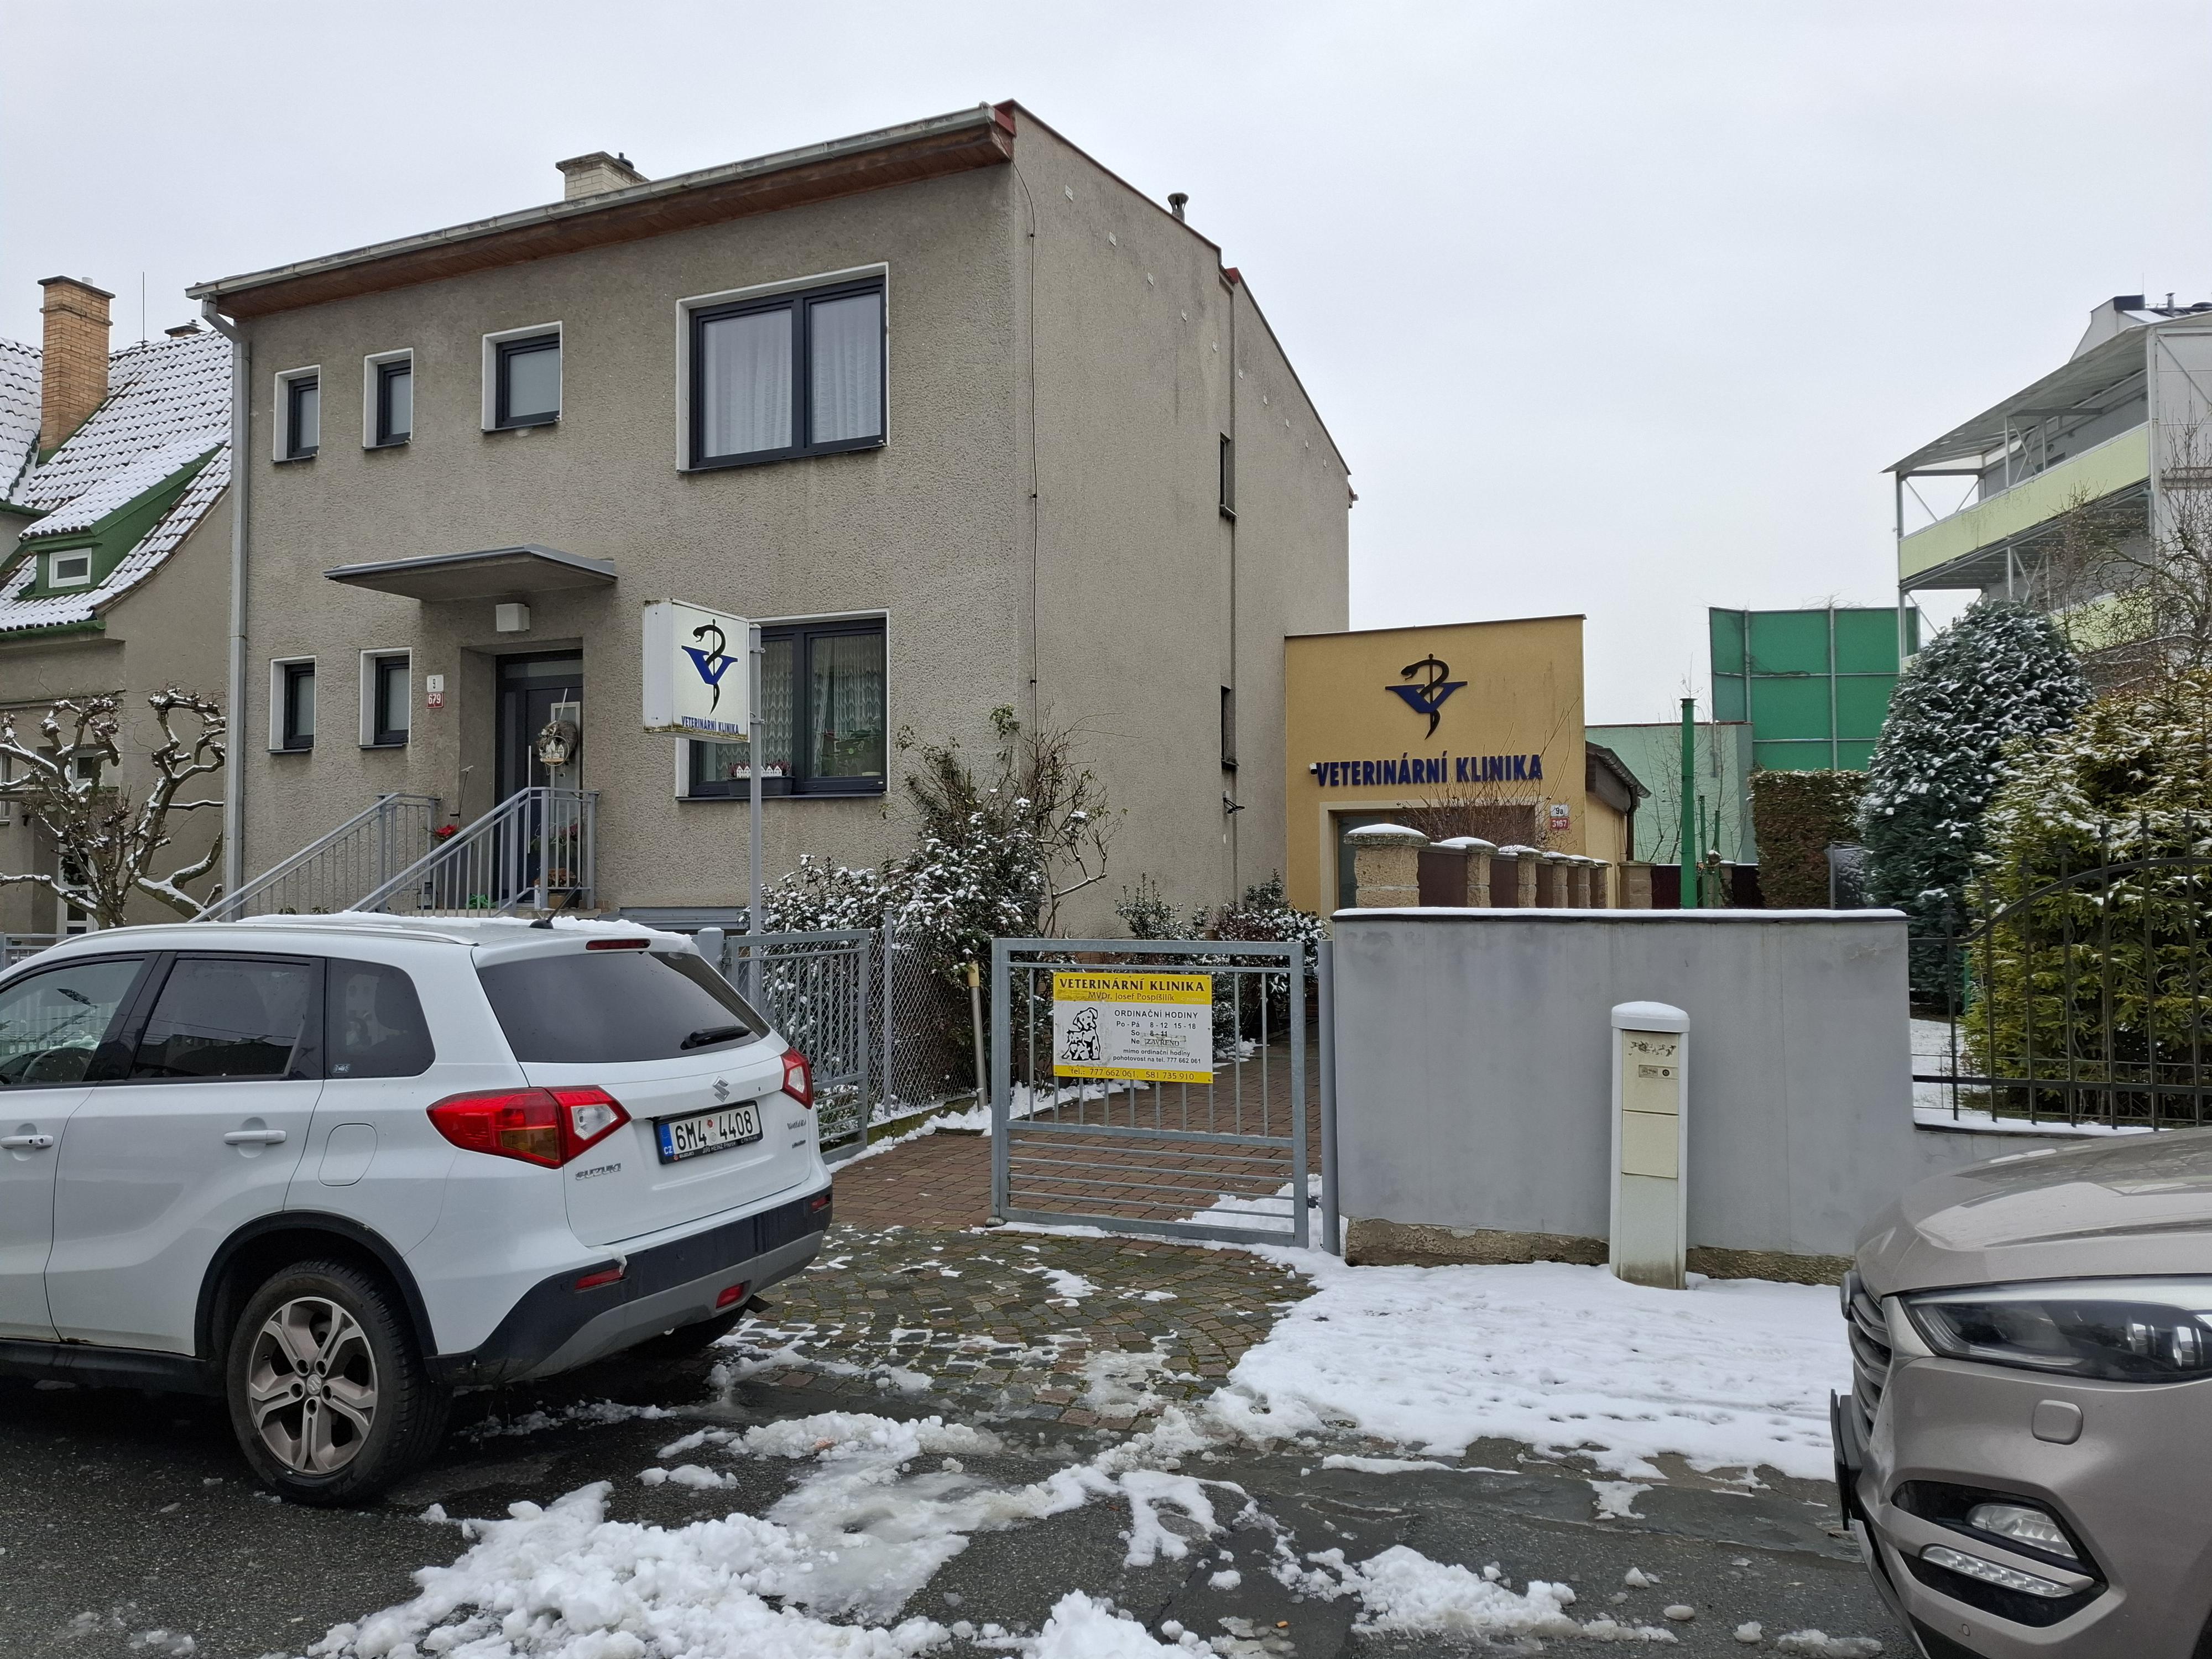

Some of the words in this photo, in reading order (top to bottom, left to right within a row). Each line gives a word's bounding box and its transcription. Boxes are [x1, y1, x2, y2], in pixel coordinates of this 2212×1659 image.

[432, 679, 436, 689] 9
[428, 693, 441, 704] 679
[681, 715, 716, 731] VETERINÁRNÍ
[718, 722, 739, 734] KLINIKA
[1316, 750, 1448, 786] VETERINÁRNÍ
[1456, 754, 1543, 782] KLINIKA
[1060, 977, 1144, 990] VETERINÁRNÍ
[1150, 980, 1204, 992] KLINIKA
[1088, 992, 1113, 1000] MVDr.
[1115, 993, 1134, 1001] Josef
[1137, 993, 1175, 1002] Pospíšilík
[1114, 1009, 1162, 1018] ORDINAČNÍ
[1147, 1038, 1180, 1046] ZAVŘENO
[675, 1120, 707, 1151] 6M4
[719, 1110, 753, 1140] 4408
[664, 1146, 672, 1155] CZ
[575, 1162, 622, 1181] SUZUKI
